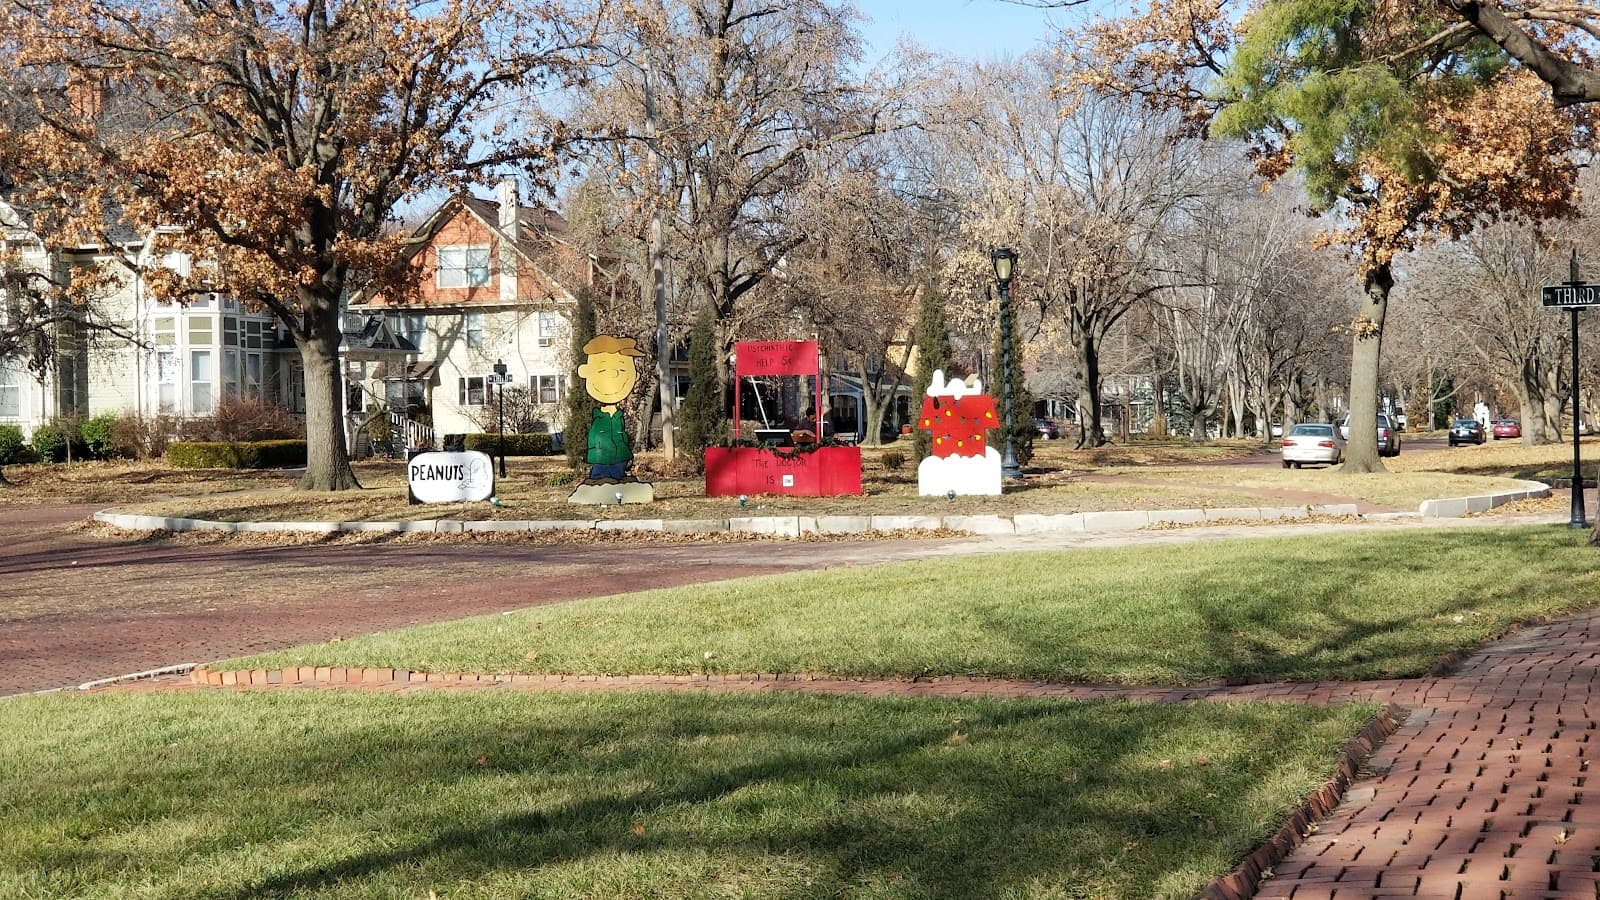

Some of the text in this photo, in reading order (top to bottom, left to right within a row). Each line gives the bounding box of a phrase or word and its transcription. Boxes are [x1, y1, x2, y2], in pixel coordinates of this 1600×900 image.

[1554, 287, 1595, 305] THIRD
[756, 358, 774, 368] HELP
[752, 457, 807, 469] THE DOCTOR
[411, 464, 464, 481] PEANUTS
[766, 475, 775, 485] IS
